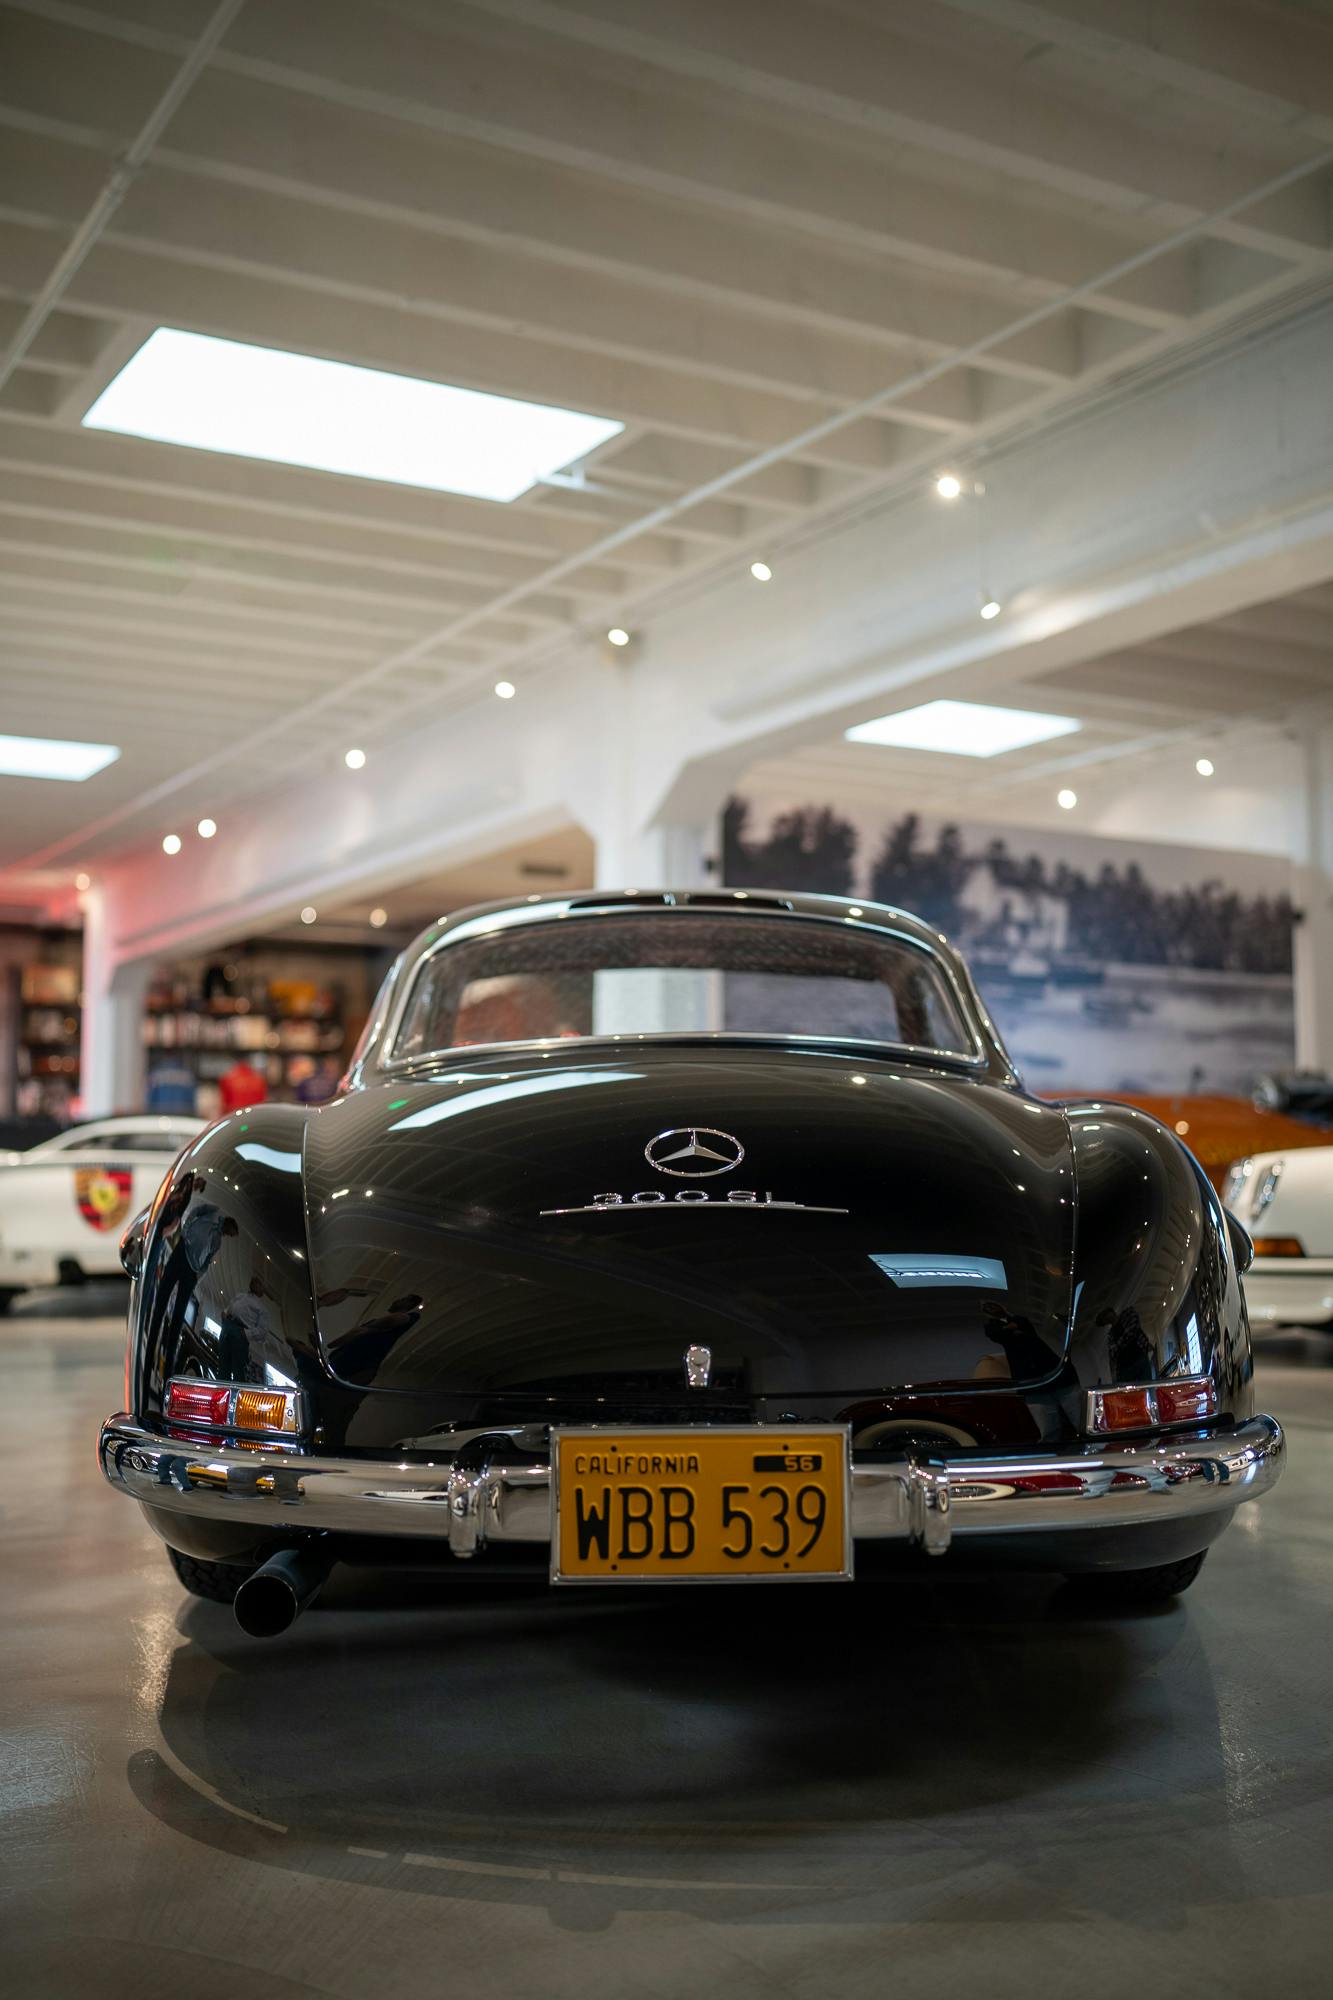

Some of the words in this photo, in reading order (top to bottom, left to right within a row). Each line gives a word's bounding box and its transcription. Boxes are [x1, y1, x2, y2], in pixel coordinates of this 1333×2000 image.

[593, 1191, 709, 1205] 300
[575, 1455, 699, 1474] CALIFORNIA
[784, 1456, 814, 1472] 56
[575, 1486, 695, 1560] WBB
[722, 1485, 826, 1559] 539
